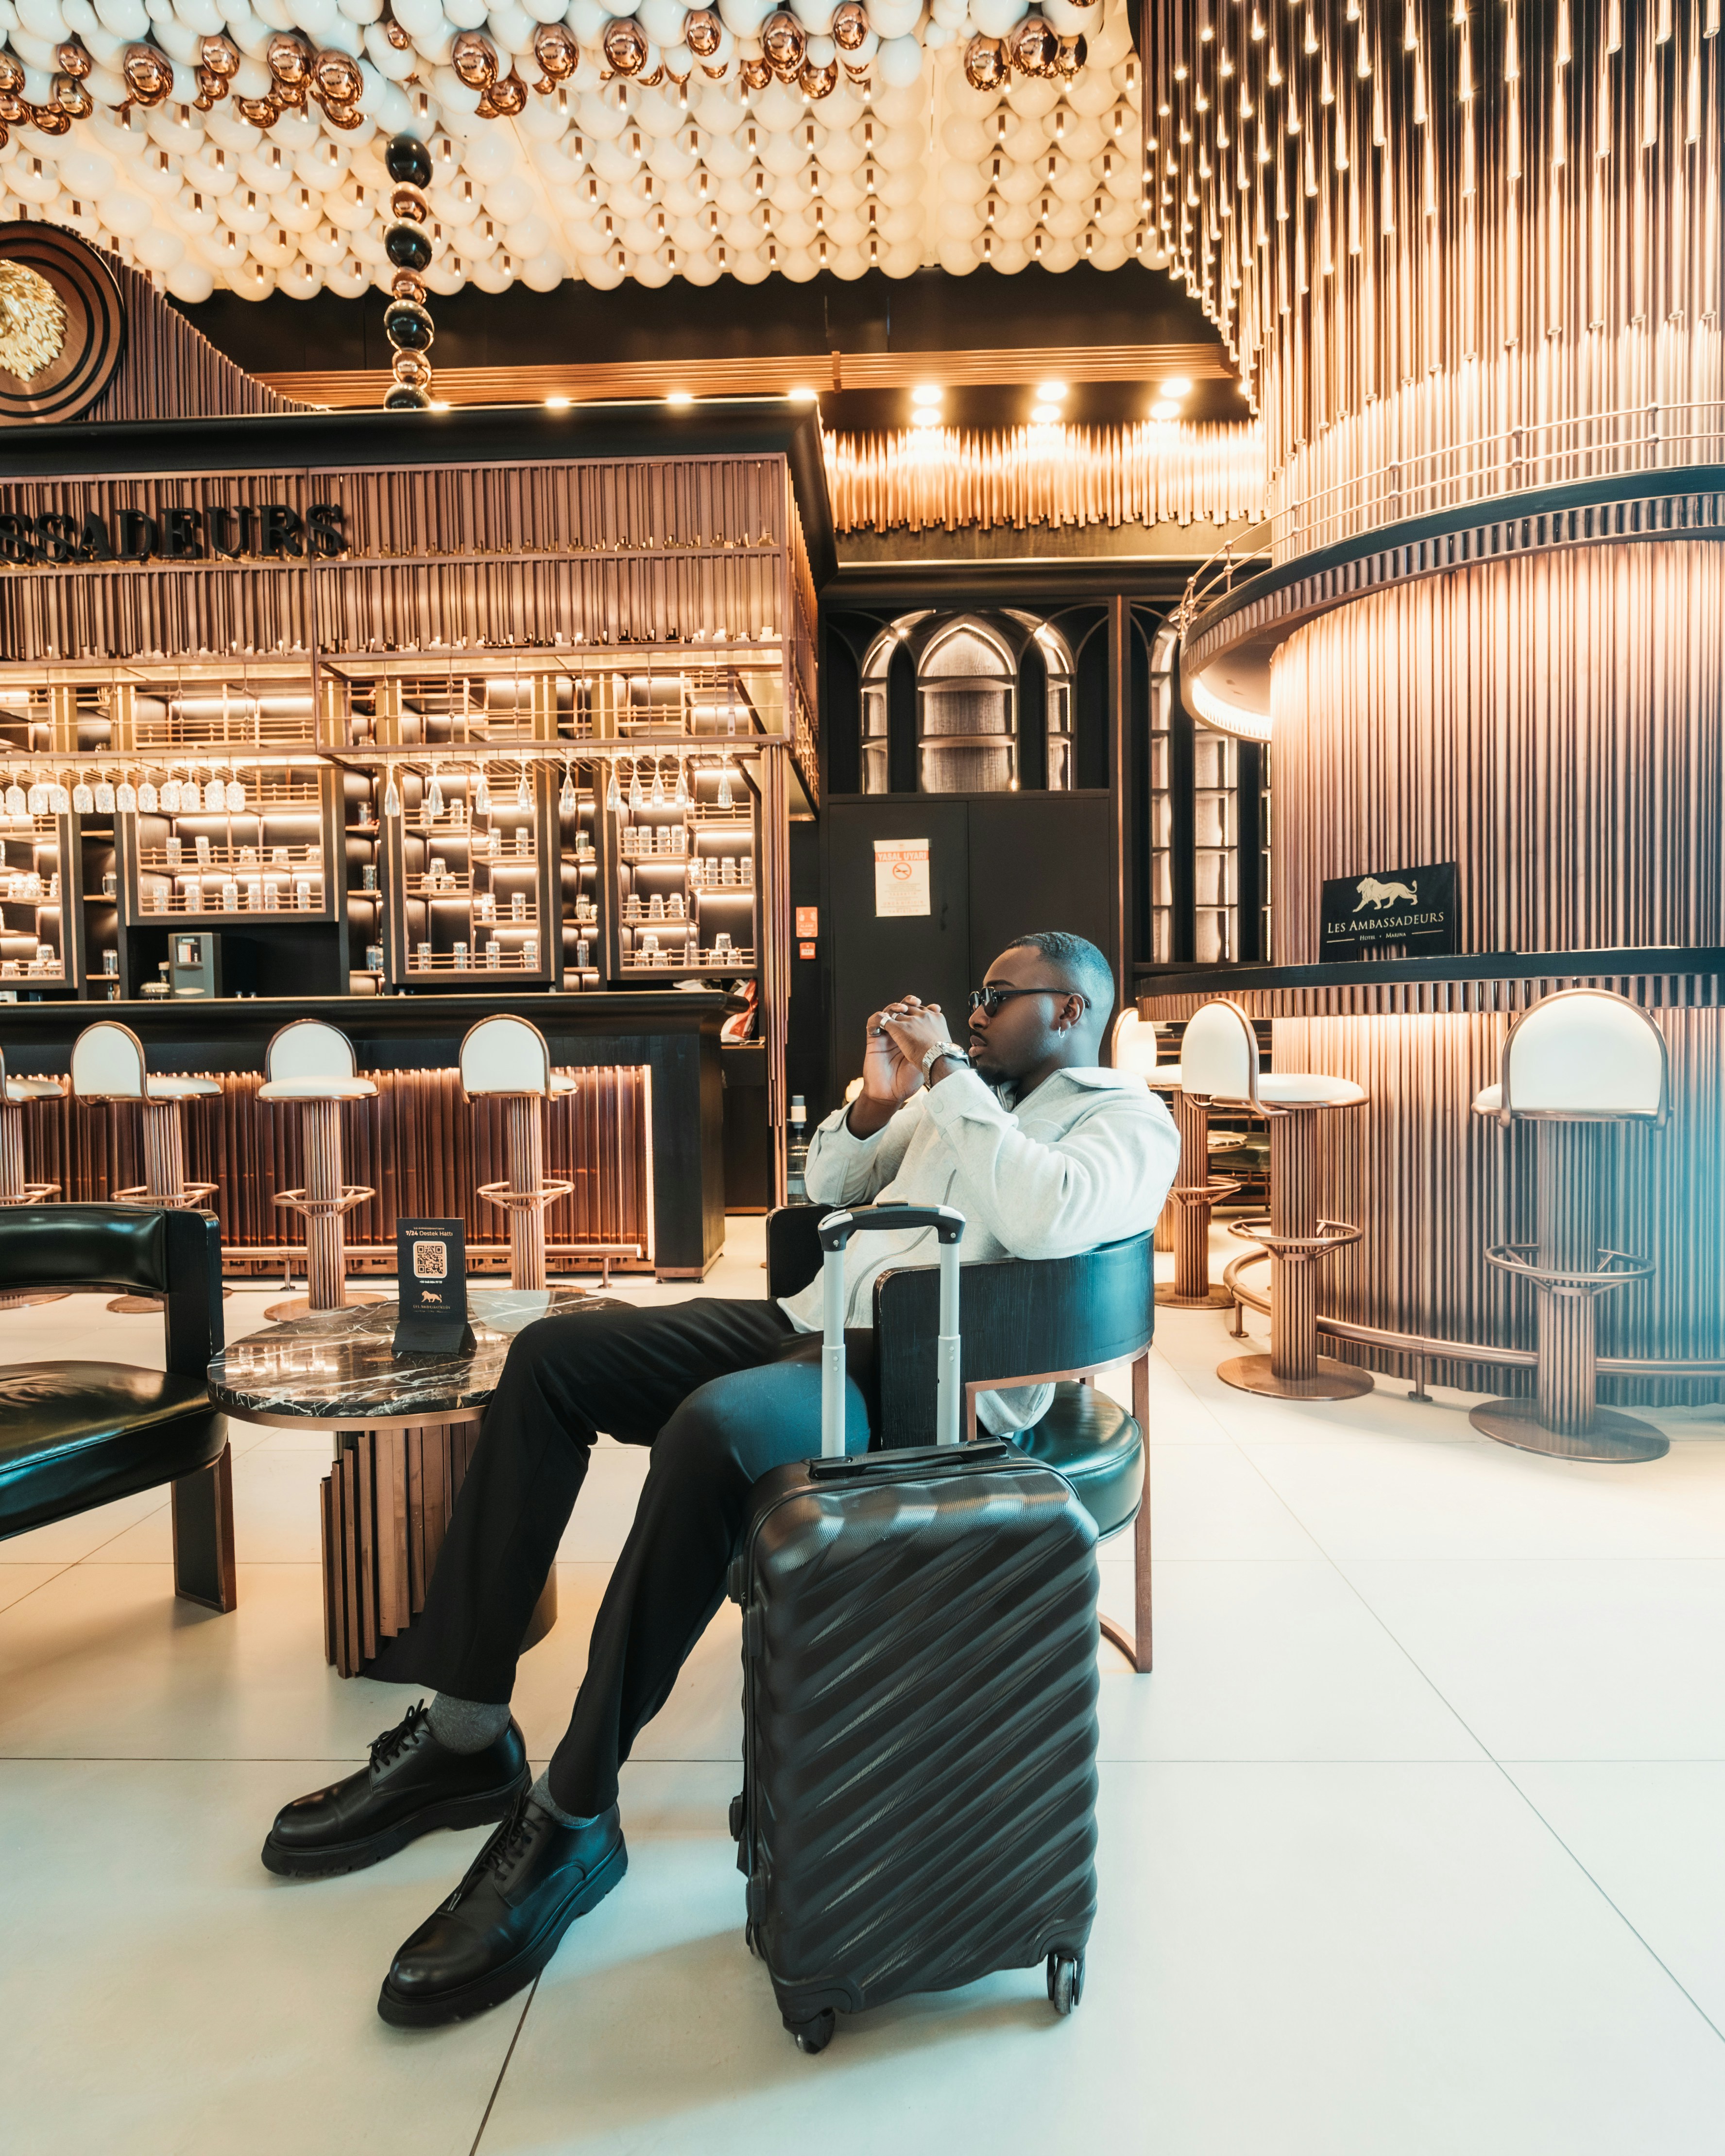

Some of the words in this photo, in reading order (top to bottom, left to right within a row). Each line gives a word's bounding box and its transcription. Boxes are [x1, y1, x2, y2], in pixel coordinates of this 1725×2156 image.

[878, 852, 902, 861] YASAL
[904, 852, 926, 861] UYARI
[1328, 922, 1346, 934] LES
[1349, 912, 1444, 932] AMBASSADEURS
